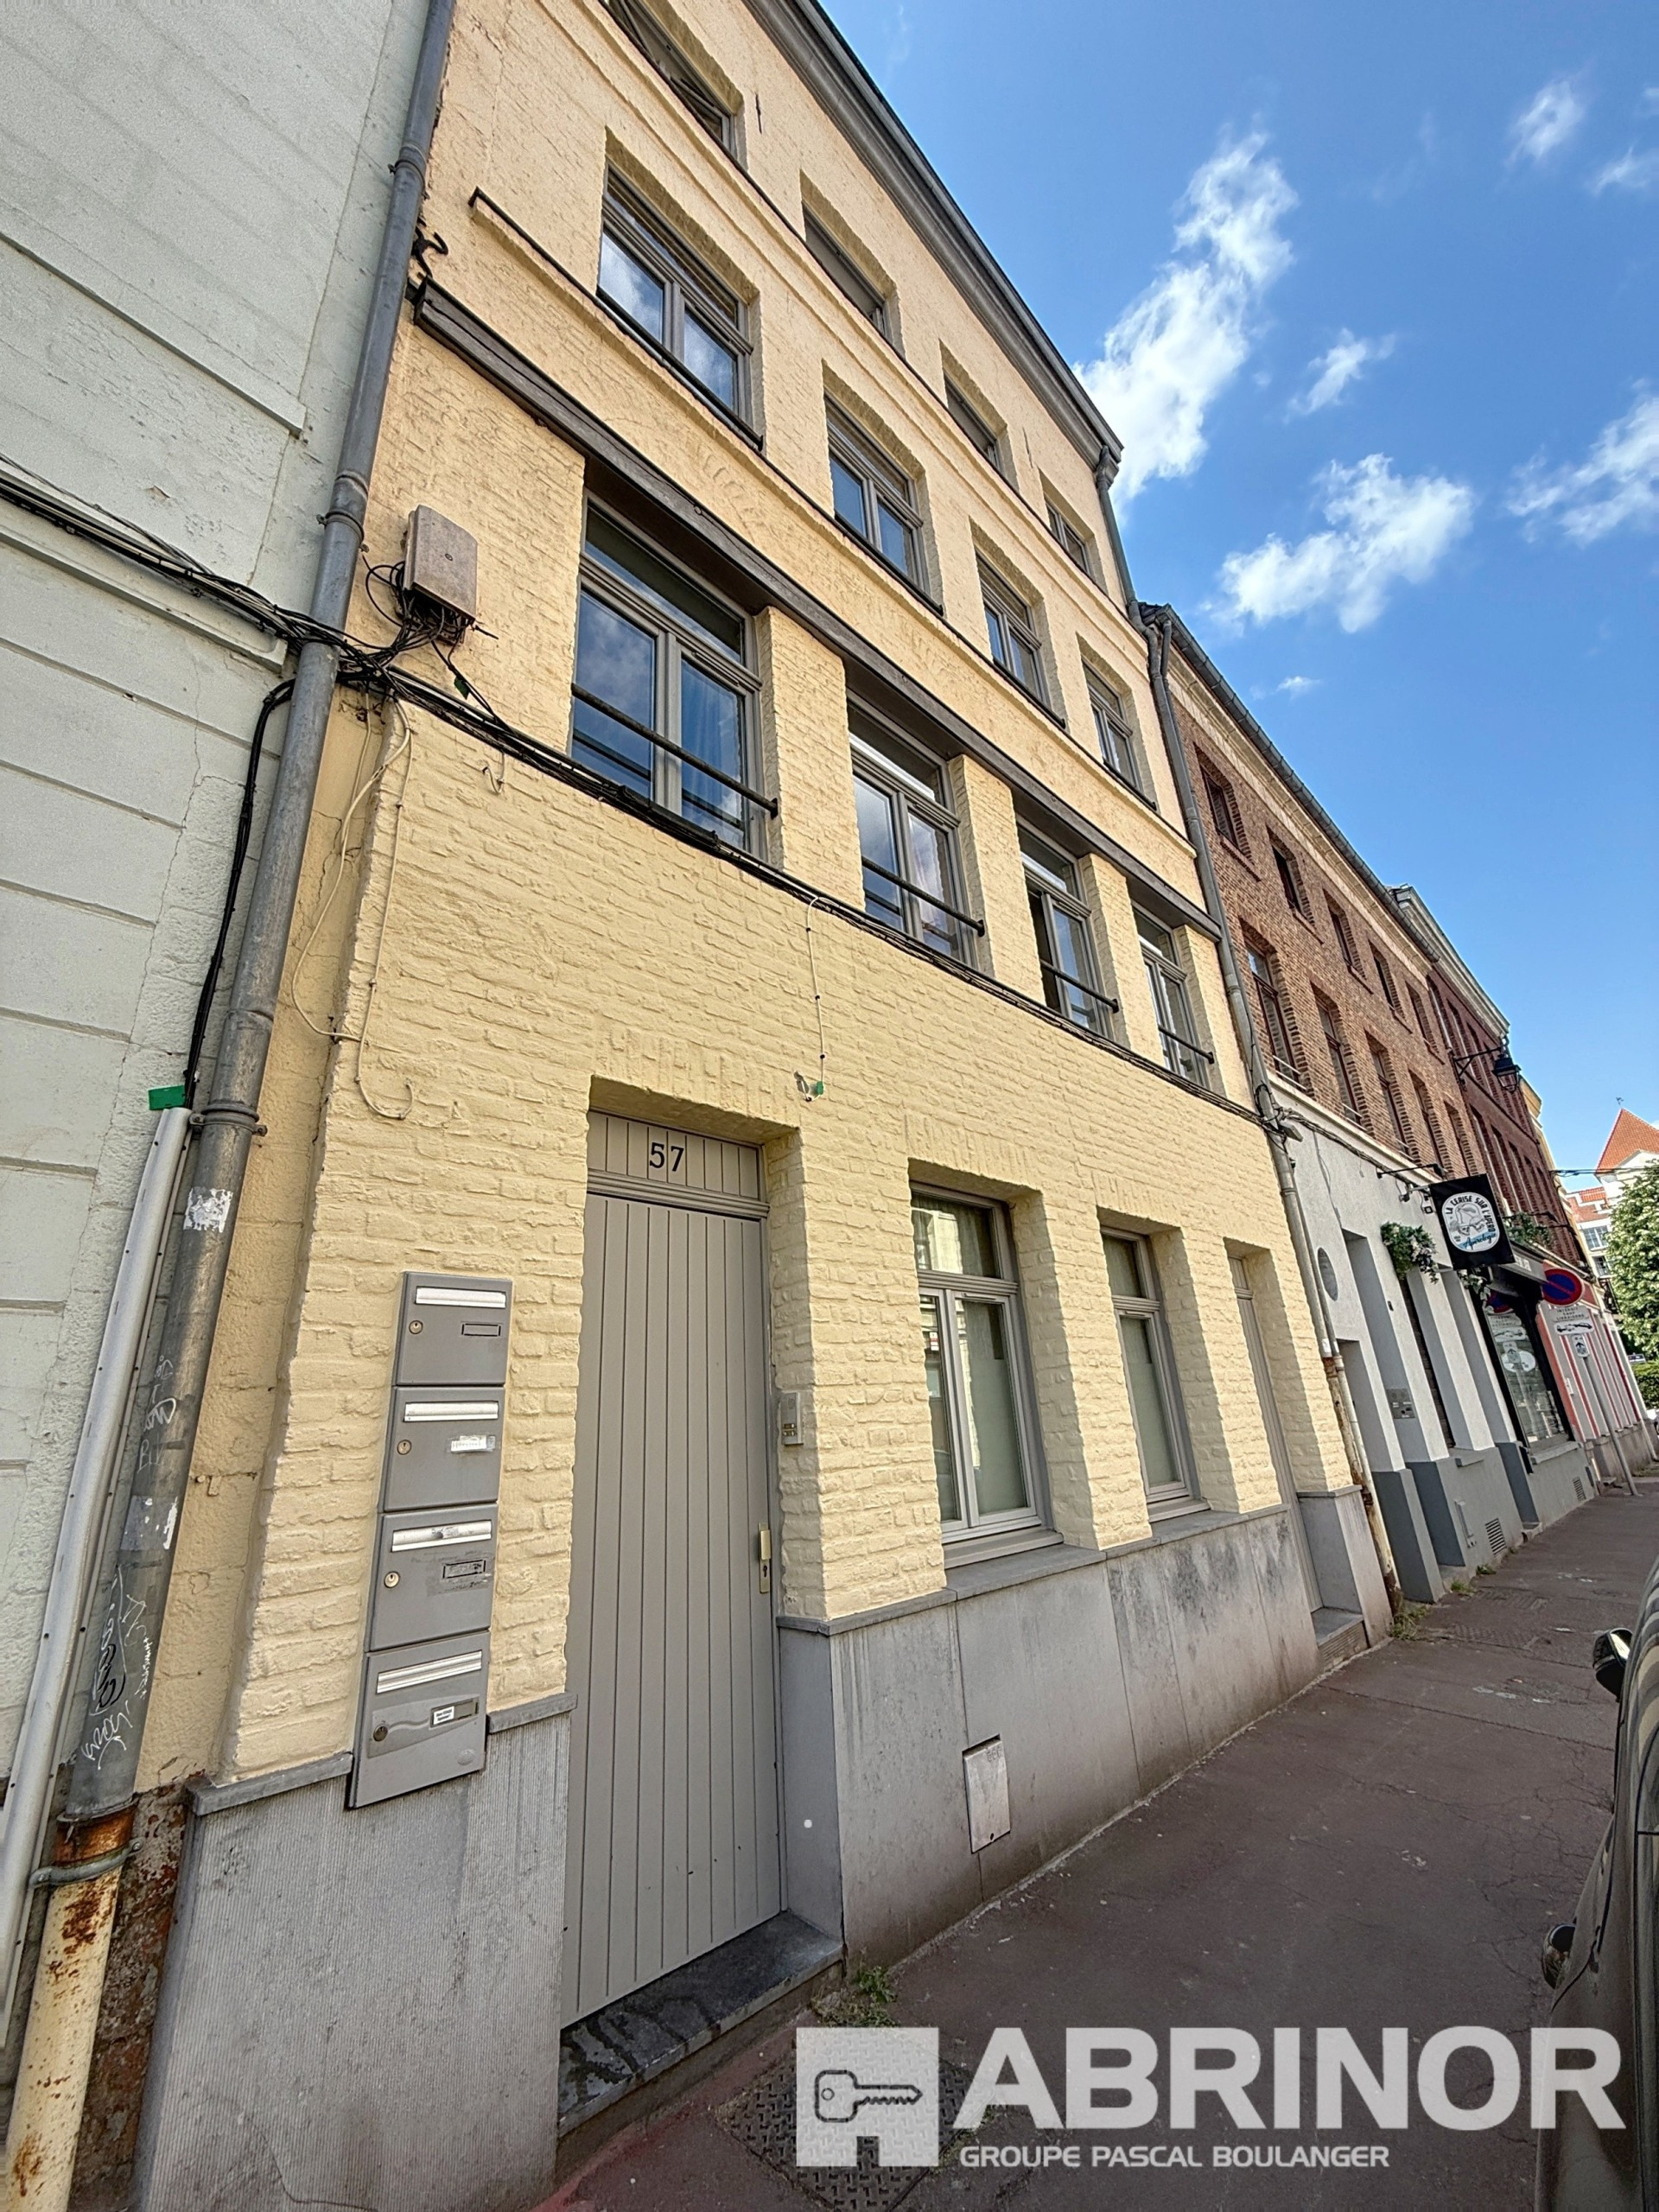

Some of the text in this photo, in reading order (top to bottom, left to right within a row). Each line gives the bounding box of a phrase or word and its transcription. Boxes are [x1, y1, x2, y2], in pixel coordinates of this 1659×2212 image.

[649, 1141, 684, 1172] 57
[1450, 1195, 1472, 1206] CERISE
[1474, 1197, 1488, 1209] SUR
